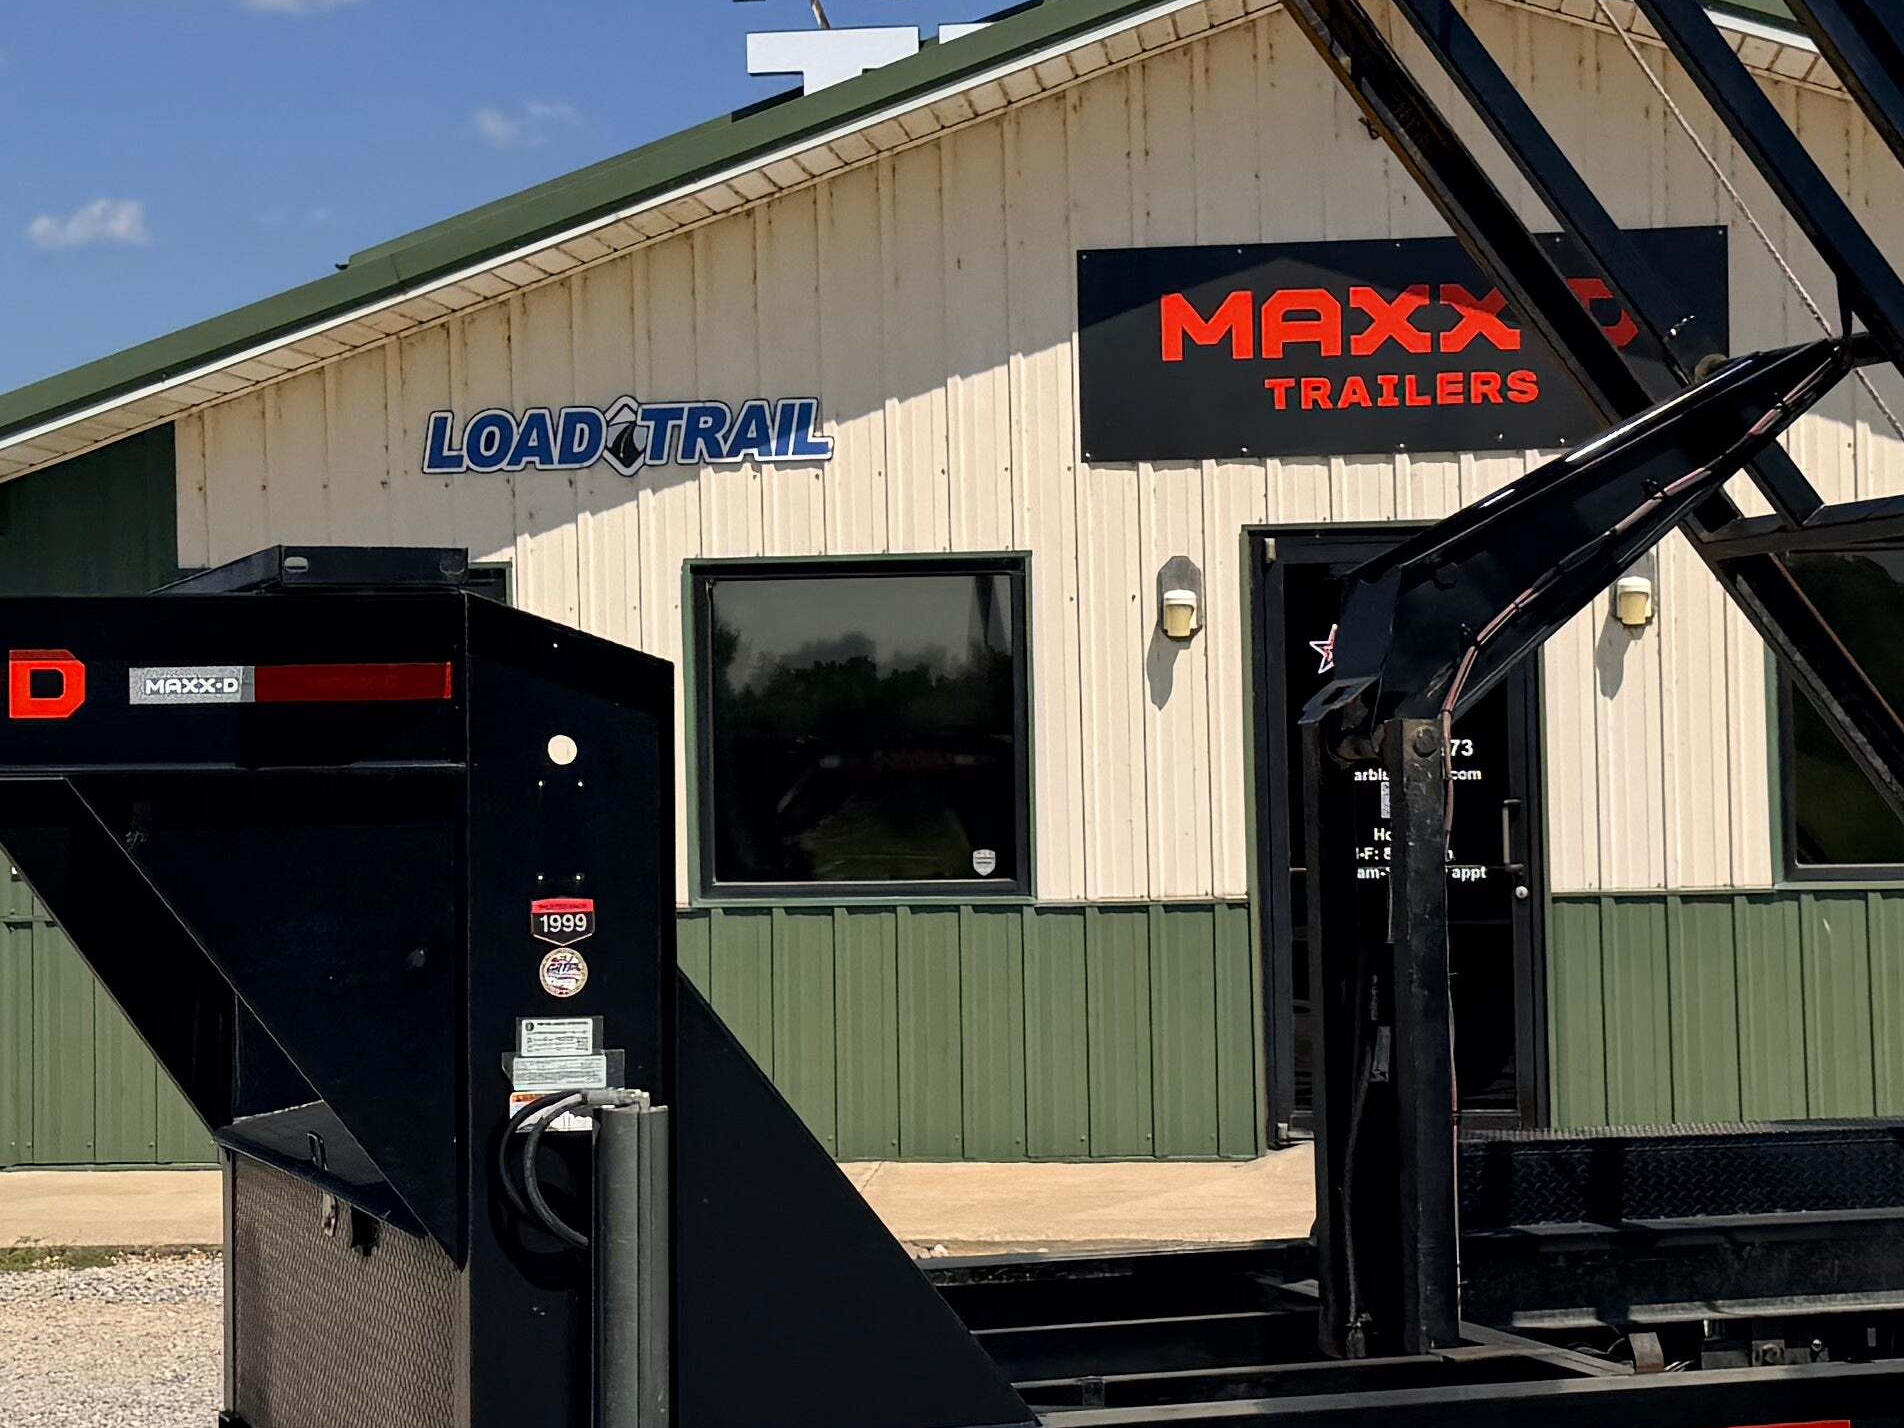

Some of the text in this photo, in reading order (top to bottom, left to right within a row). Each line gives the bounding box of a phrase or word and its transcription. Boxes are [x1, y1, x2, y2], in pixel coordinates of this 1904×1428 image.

[1264, 369, 1539, 410] TRAILERS
[424, 398, 834, 473] LOAD TRAIL
[144, 677, 240, 695] MAXX-D
[1451, 866, 1487, 882] appt
[539, 913, 587, 933] 1999
